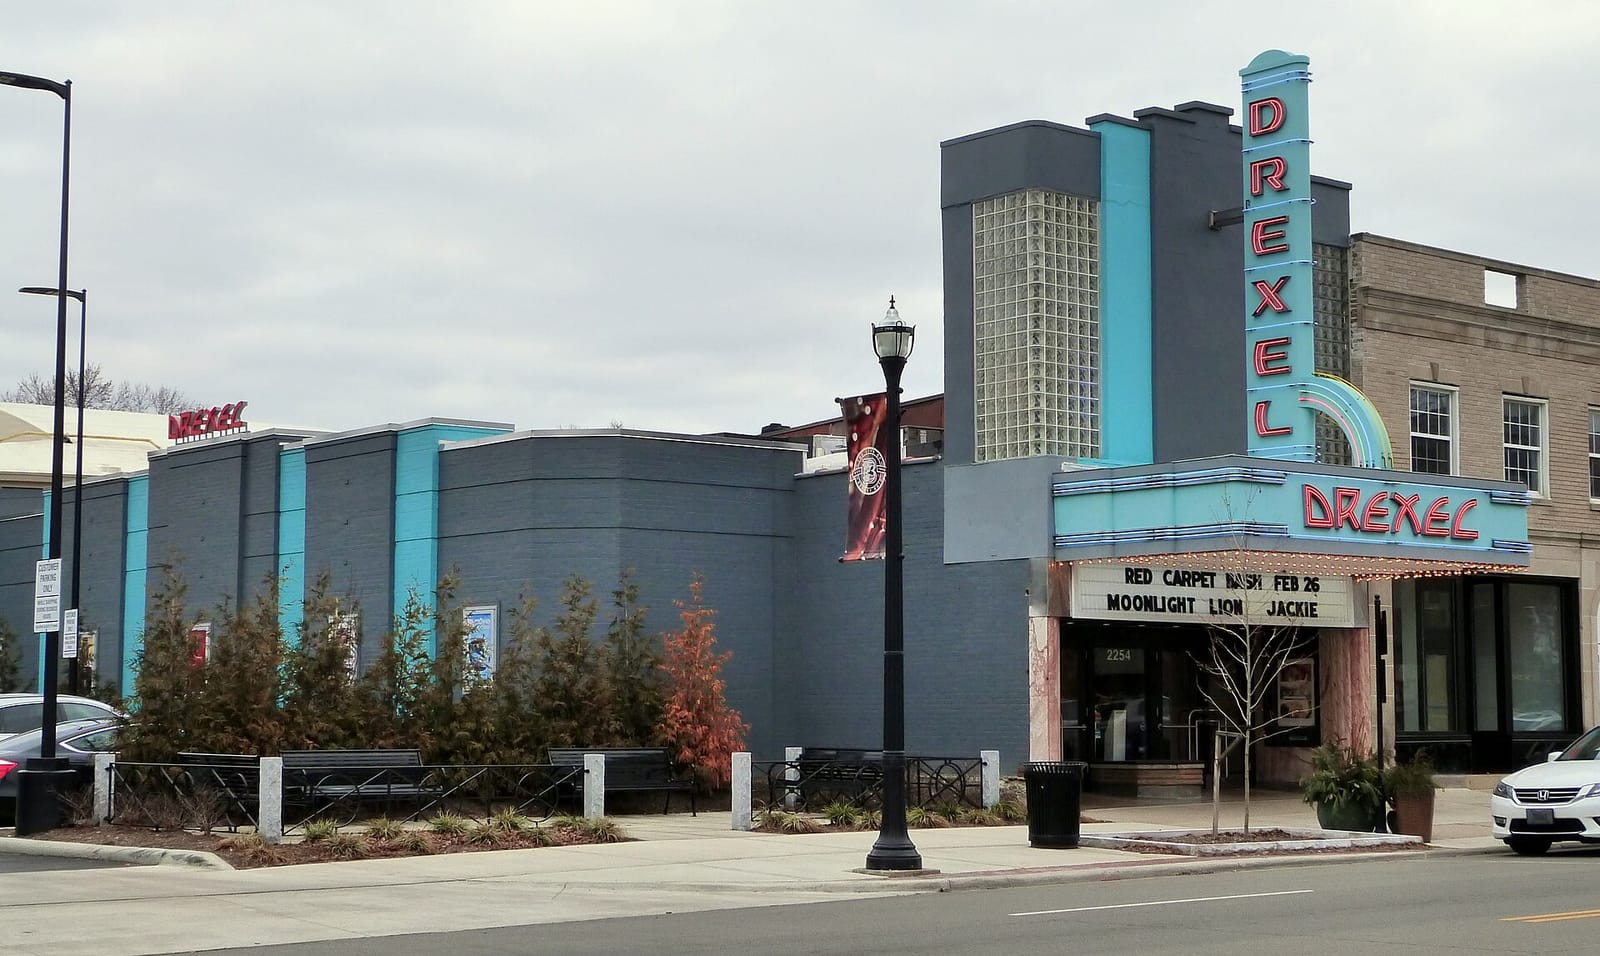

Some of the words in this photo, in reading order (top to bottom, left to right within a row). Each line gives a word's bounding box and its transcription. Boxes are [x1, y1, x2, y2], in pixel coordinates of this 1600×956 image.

[1249, 97, 1293, 437] DREXEL
[168, 401, 247, 440] DREXEL
[1303, 484, 1479, 540] DREXEL
[40, 573, 57, 583] PARKING
[43, 583, 54, 593] ONLY
[1125, 567, 1153, 585] RED
[1163, 569, 1216, 588] CARPET
[1274, 575, 1299, 592] FEB
[1303, 576, 1320, 592] 26
[1107, 593, 1196, 614] MOONLIGHT
[1209, 598, 1243, 616] LION
[1267, 600, 1319, 618] JACKIE
[1106, 649, 1131, 661] 2254
